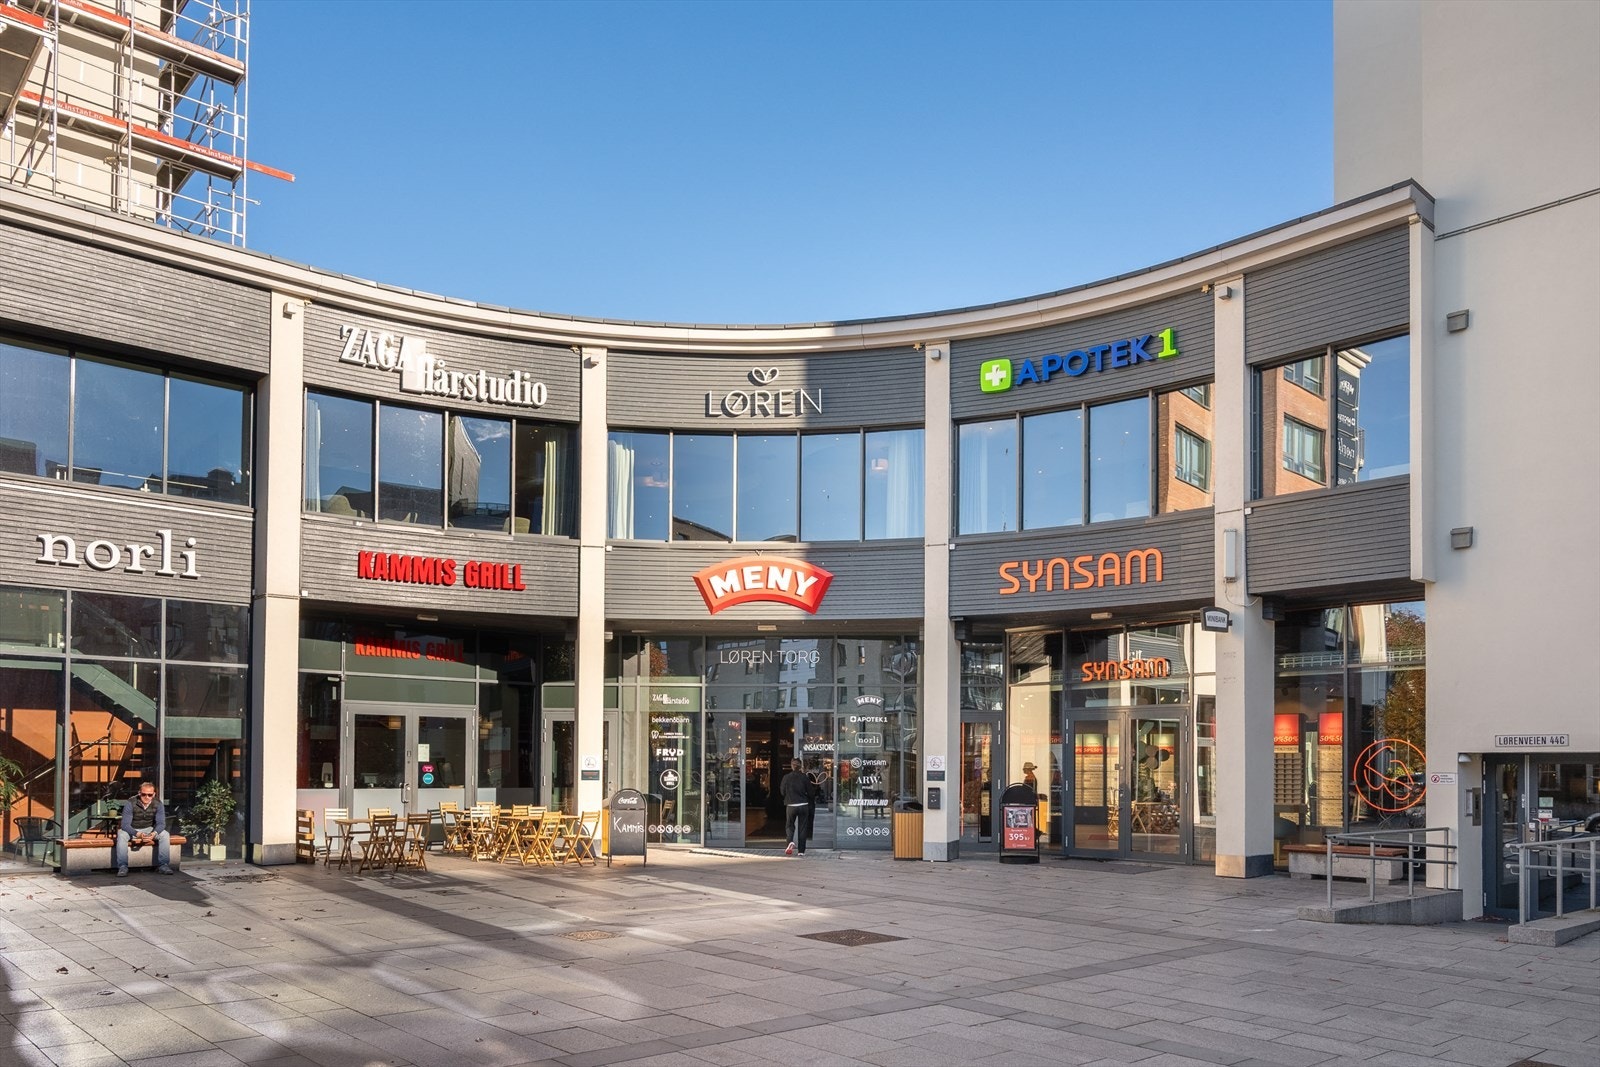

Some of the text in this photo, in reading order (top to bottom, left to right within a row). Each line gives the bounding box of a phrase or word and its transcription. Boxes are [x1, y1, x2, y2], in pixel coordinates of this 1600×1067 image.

[1016, 327, 1180, 386] APOTEK 1
[708, 388, 822, 416] LØREN
[37, 529, 201, 579] norli
[358, 550, 527, 591] KAMMIS GRILL
[708, 566, 818, 599] MENY
[999, 548, 1163, 595] SYNSAM
[720, 649, 820, 664] LØREN TORG
[1082, 657, 1166, 682] SYNSAM
[857, 696, 881, 704] MENY
[858, 735, 880, 744] norli
[1498, 735, 1565, 746] LØRENVEIEN 44C
[1008, 833, 1024, 841] 395
